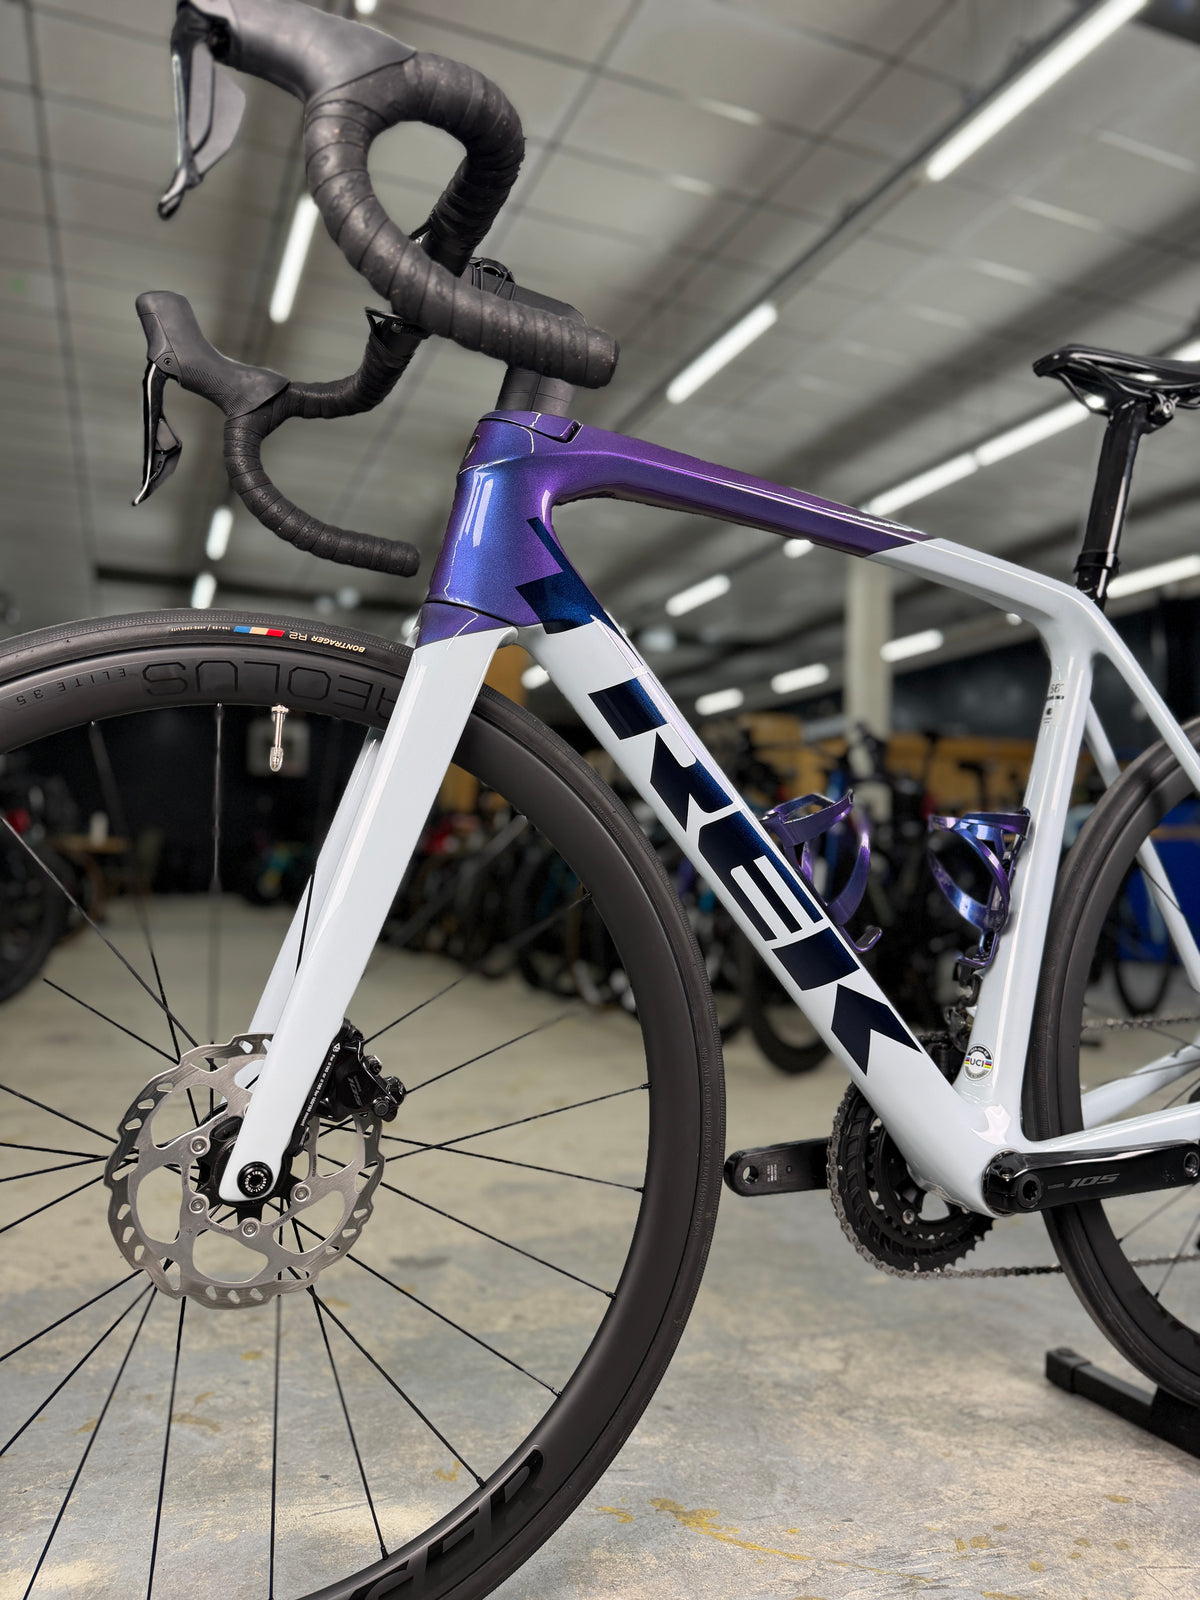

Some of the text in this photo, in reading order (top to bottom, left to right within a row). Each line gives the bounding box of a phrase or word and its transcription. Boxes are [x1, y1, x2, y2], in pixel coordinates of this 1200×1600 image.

[289, 631, 366, 653] BONTRAGER R2
[57, 667, 126, 693] ELITE
[15, 689, 44, 706] 35
[515, 516, 924, 1077] TREK
[970, 1058, 985, 1067] UCI
[1068, 1173, 1120, 1188] 105
